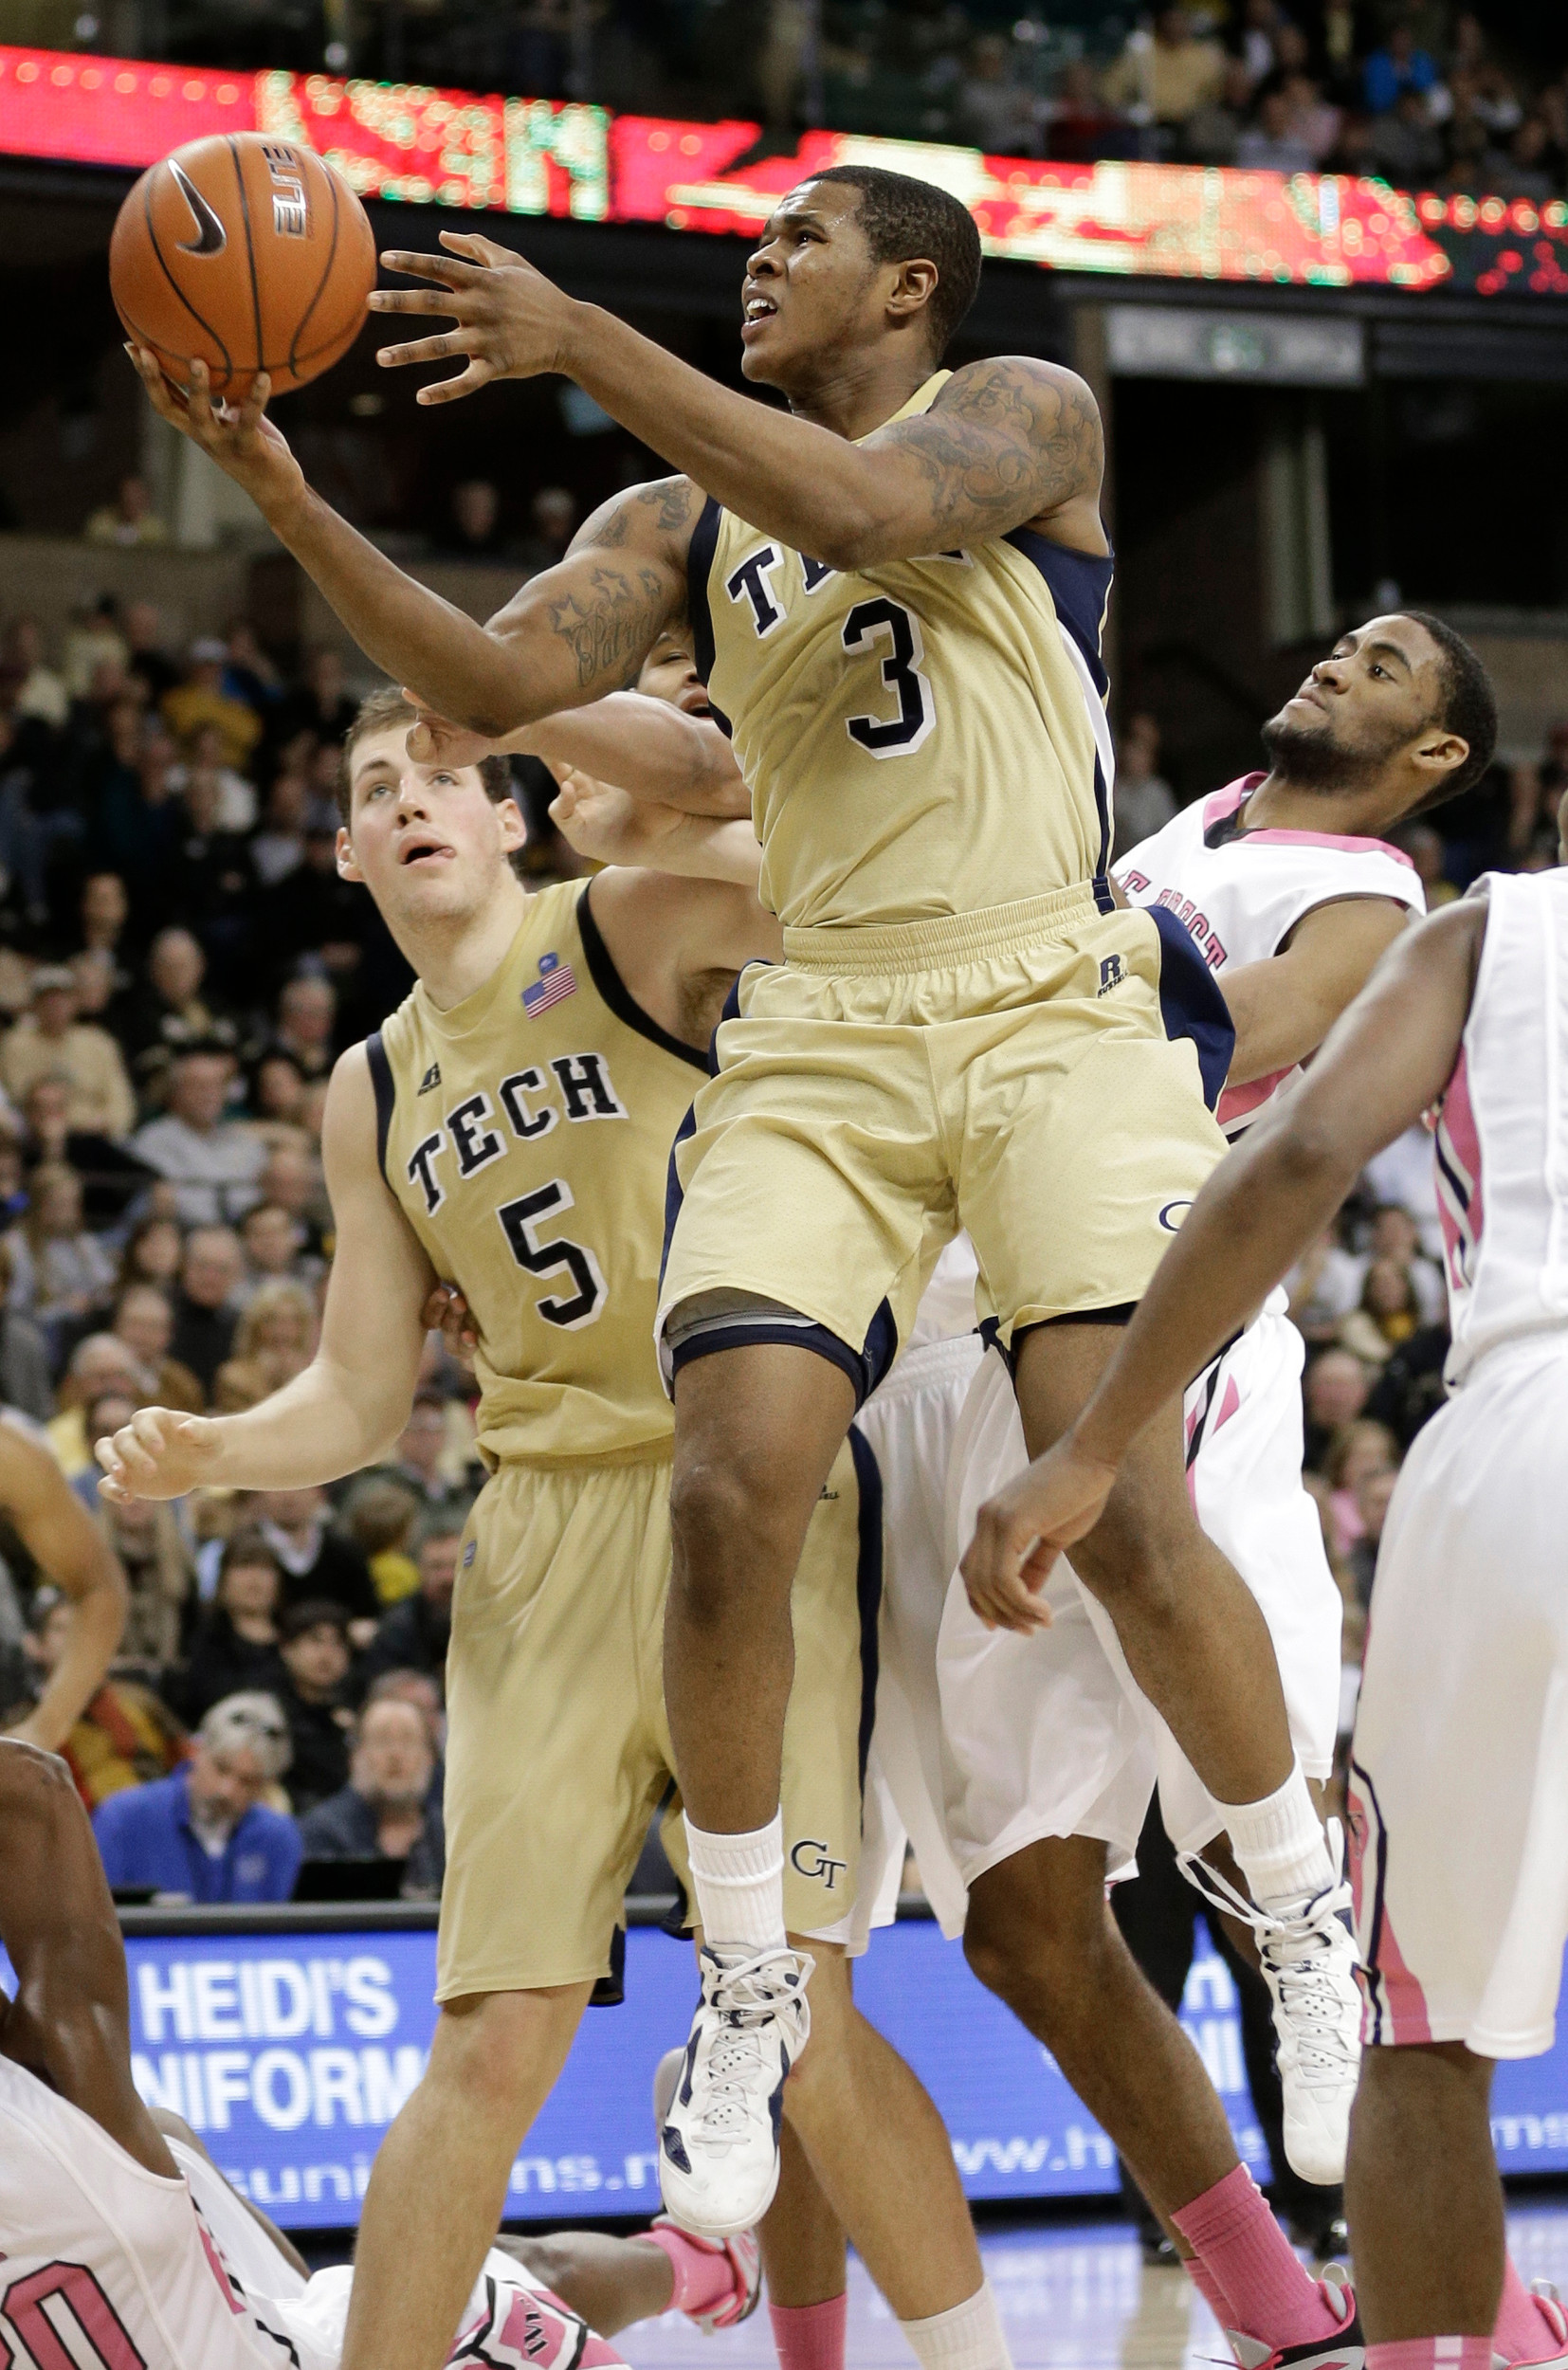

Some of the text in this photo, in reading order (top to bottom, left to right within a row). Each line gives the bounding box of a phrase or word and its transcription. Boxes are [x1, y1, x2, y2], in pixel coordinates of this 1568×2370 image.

[842, 597, 937, 759] 3
[408, 1052, 629, 1216] TECH
[496, 1178, 609, 1331] 5
[791, 1839, 847, 1889] GT
[137, 1956, 399, 2042] HEIDI'S
[131, 2046, 425, 2132] NIFORM
